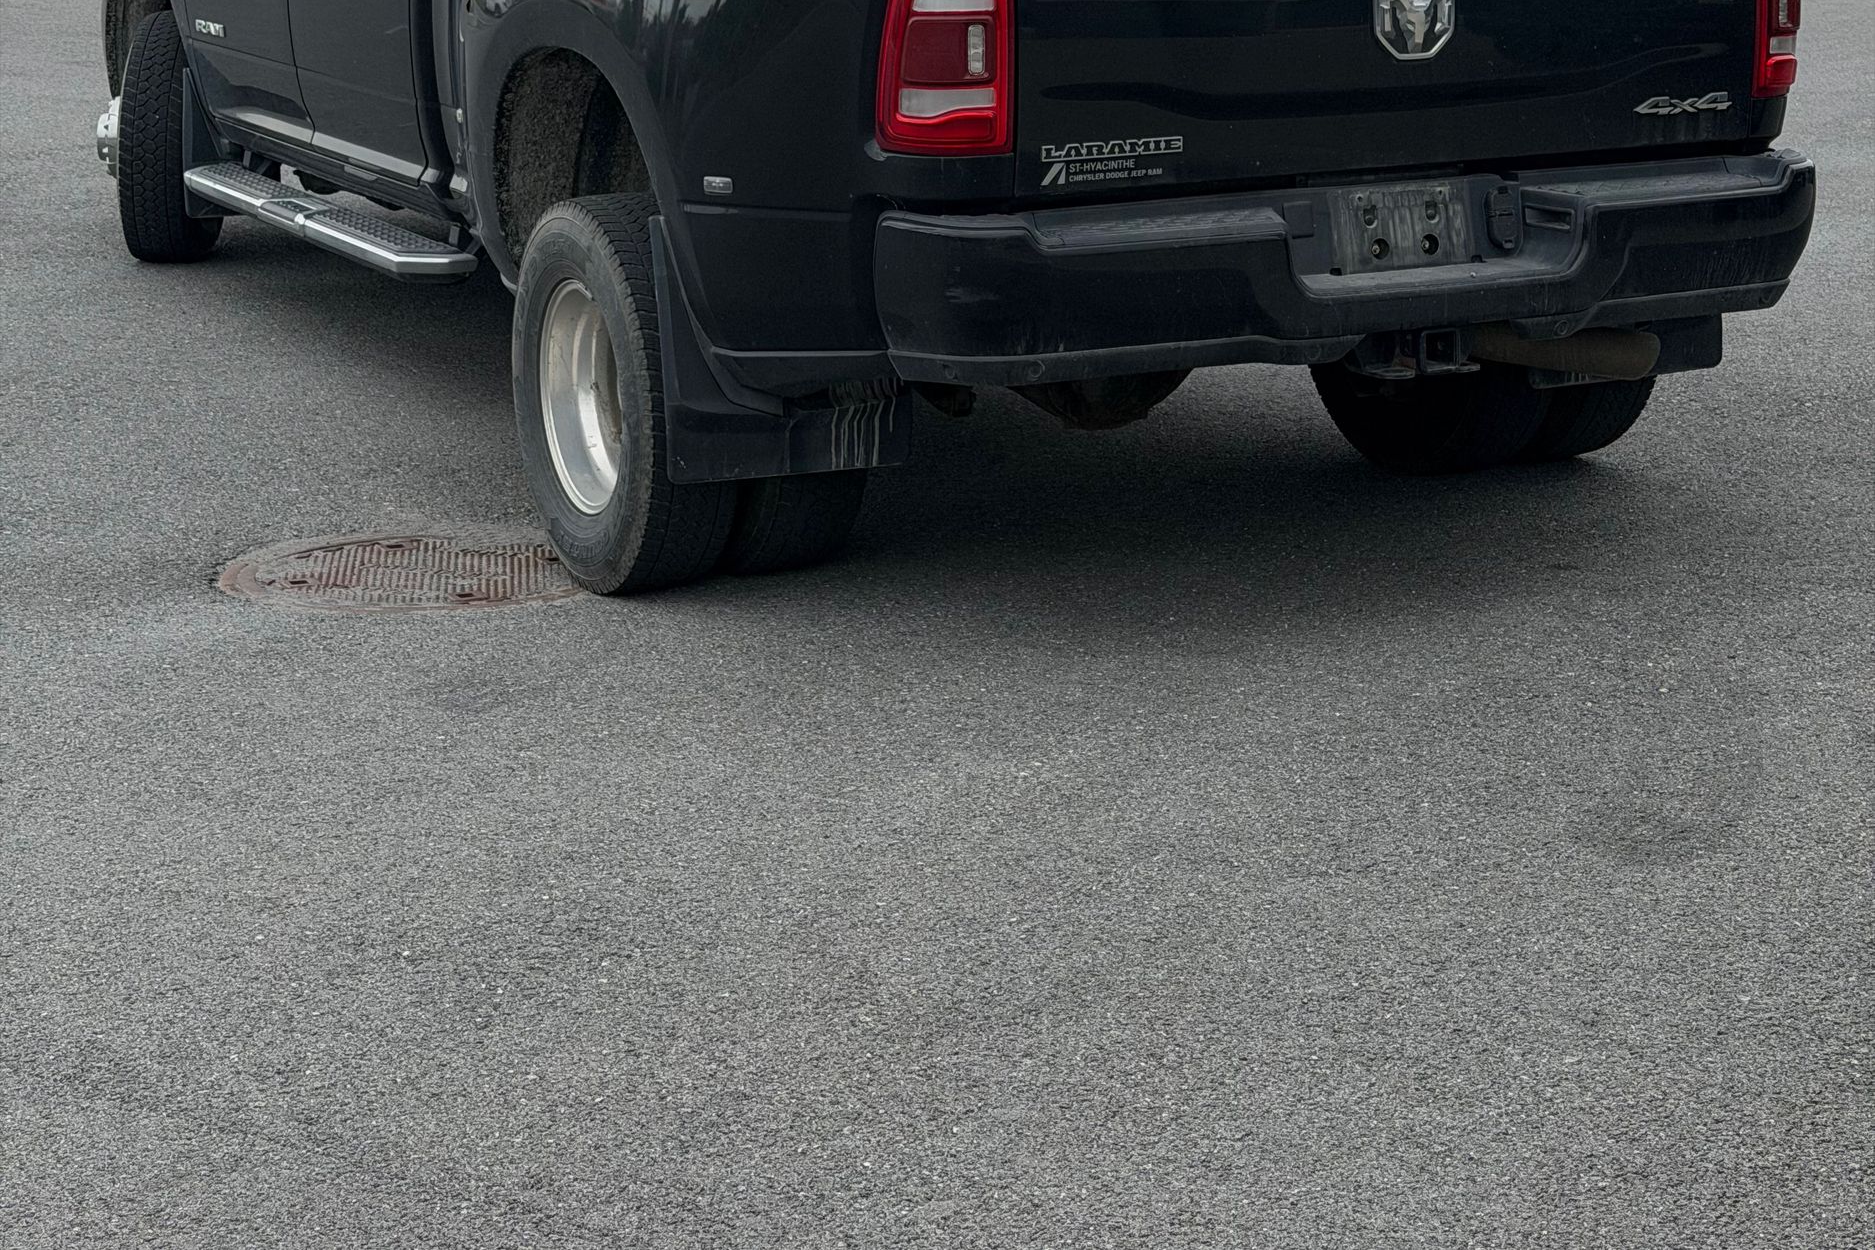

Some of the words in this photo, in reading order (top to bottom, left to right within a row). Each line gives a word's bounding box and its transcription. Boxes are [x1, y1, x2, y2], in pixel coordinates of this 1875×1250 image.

[1041, 136, 1184, 162] LARAMIE
[1069, 158, 1136, 173] ST-HYACINTHE
[1068, 172, 1105, 182] CHRYSLER
[1105, 170, 1129, 179] DODGE
[1130, 169, 1146, 178] JEEP
[1147, 167, 1163, 176] RAM
